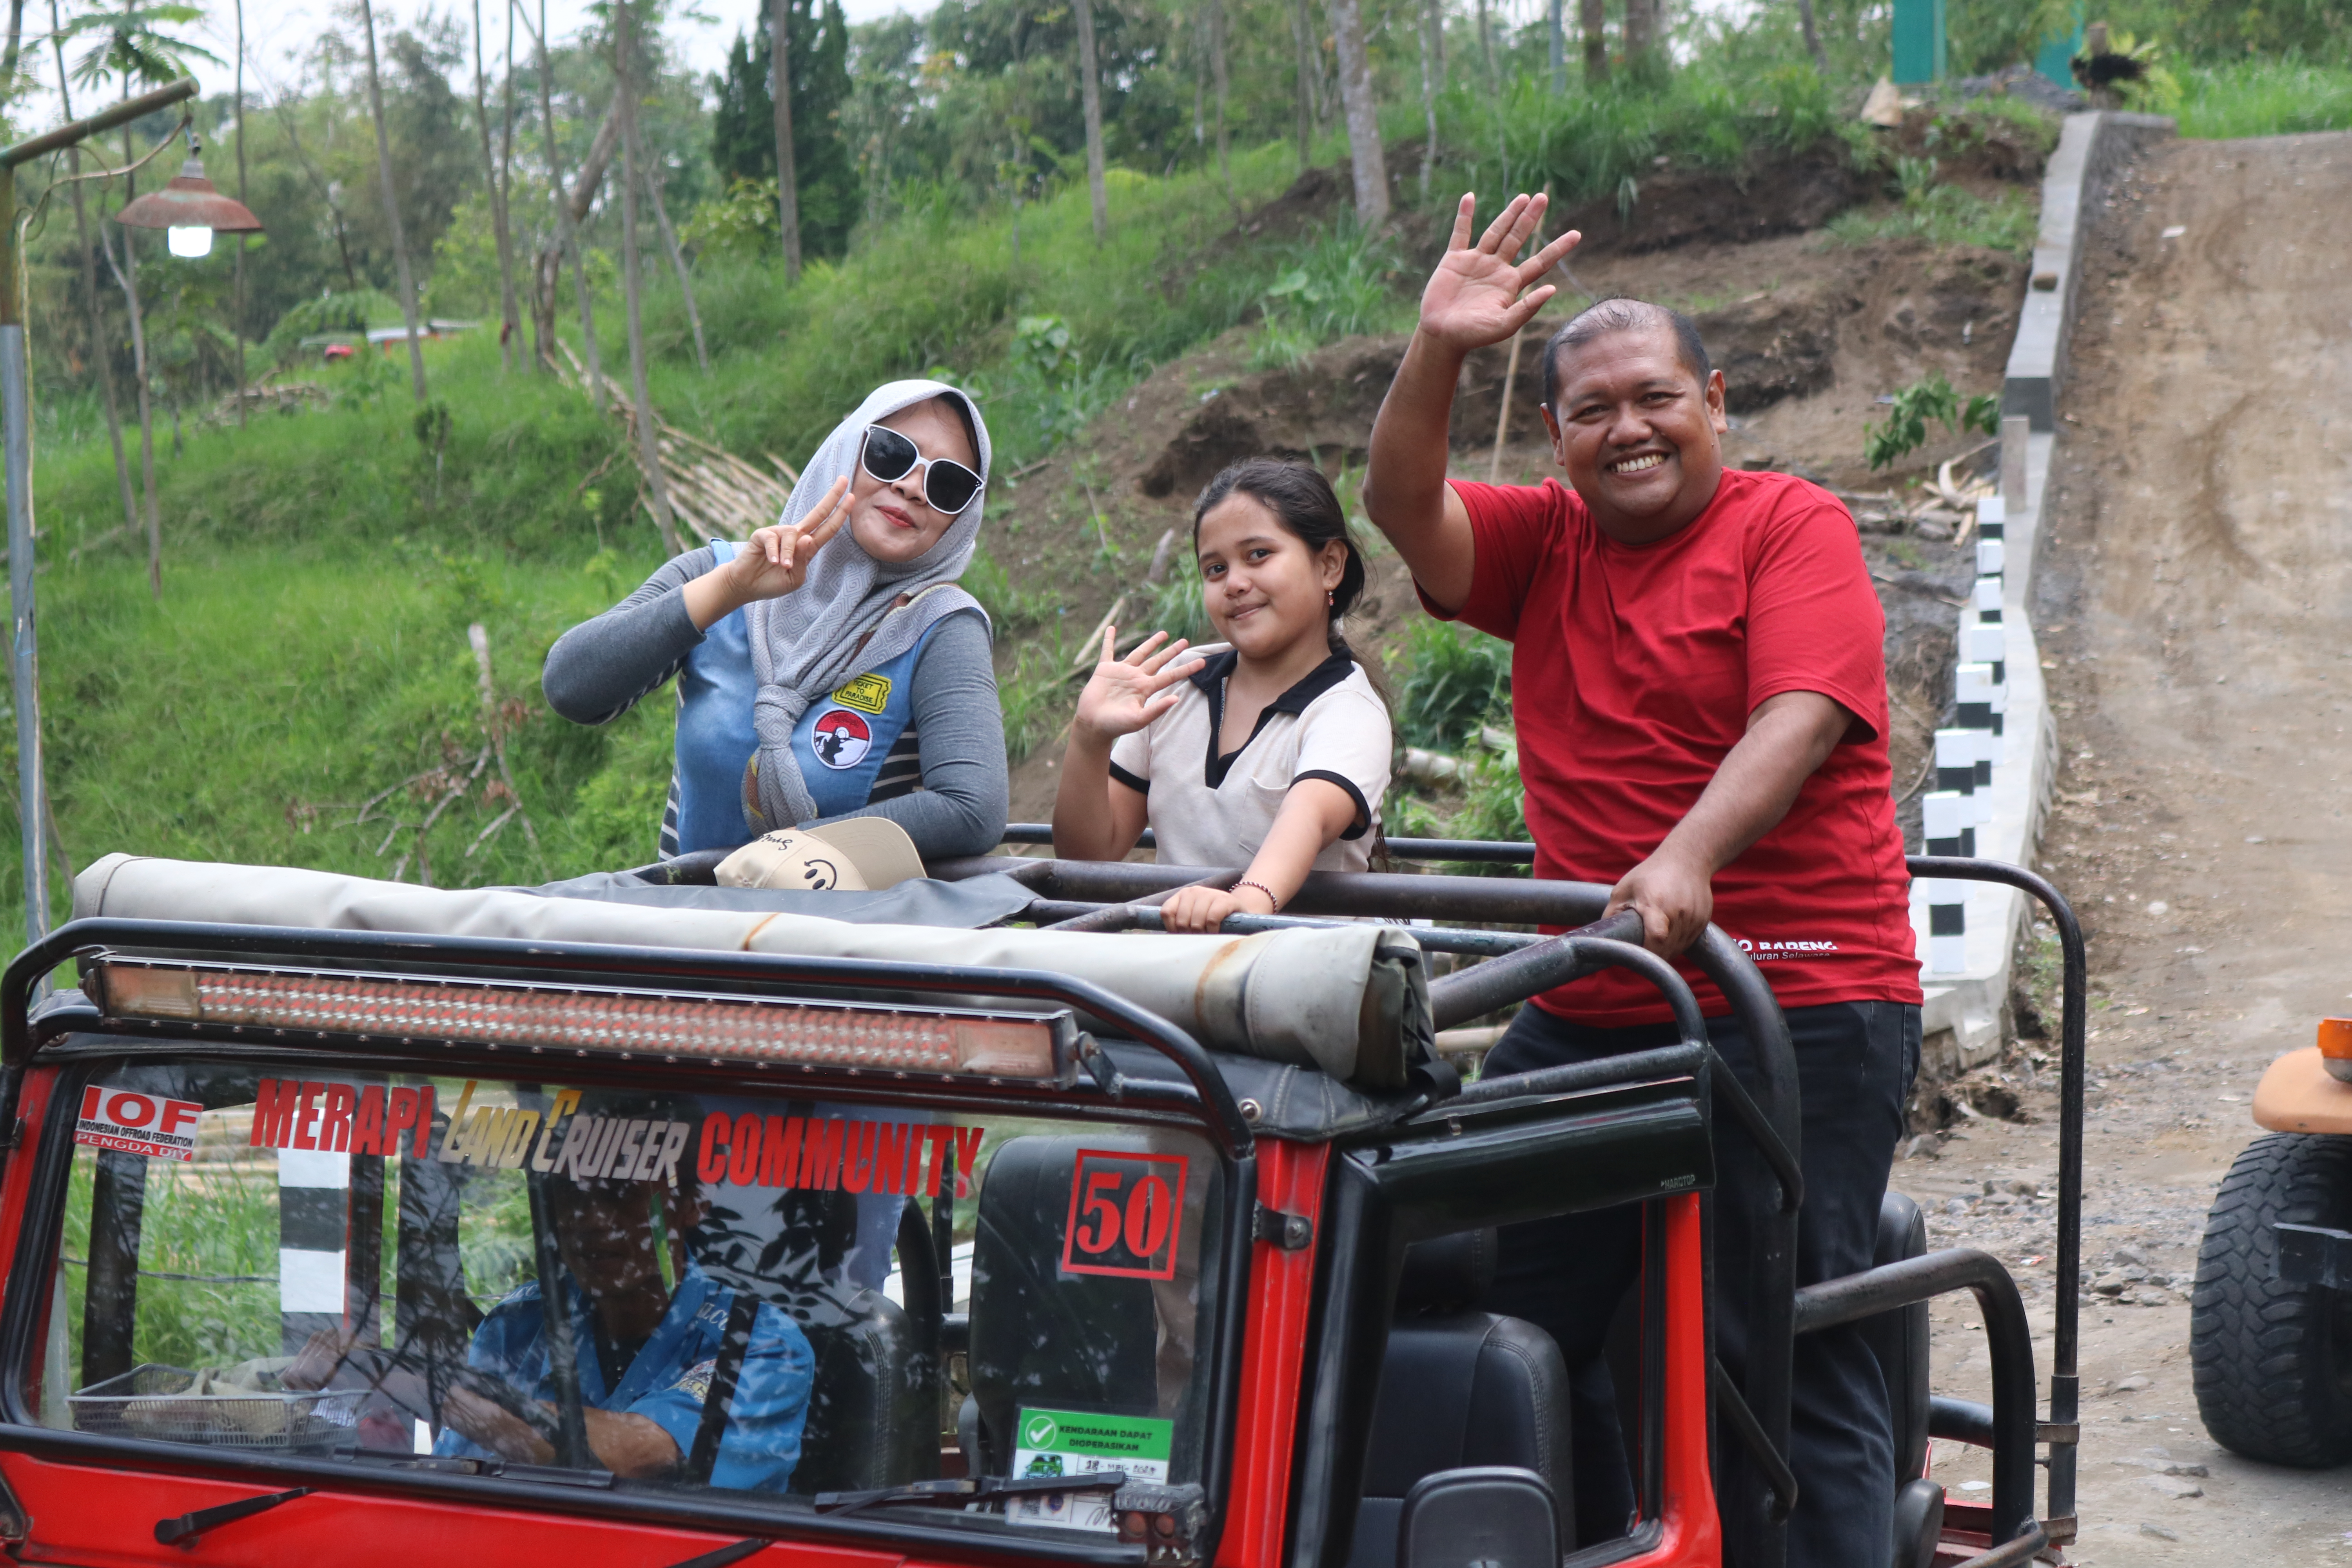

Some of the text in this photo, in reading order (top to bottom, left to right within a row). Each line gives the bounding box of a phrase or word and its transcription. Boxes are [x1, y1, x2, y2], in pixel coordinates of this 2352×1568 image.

[845, 691, 873, 703] PARADISE
[853, 680, 873, 690] TICKET
[80, 1086, 203, 1134] IOF
[76, 1133, 191, 1161] PENGDA DIY
[78, 1120, 194, 1148] INDONESIAN OFFROAD FEDERATION
[250, 1078, 985, 1199] MERAPI LAND CRUISER COMMUNITY
[1076, 1171, 1171, 1258] 50
[1059, 1426, 1153, 1440] KENDARAAN DAPAT
[1069, 1439, 1140, 1451] DIOPERASIKAN
